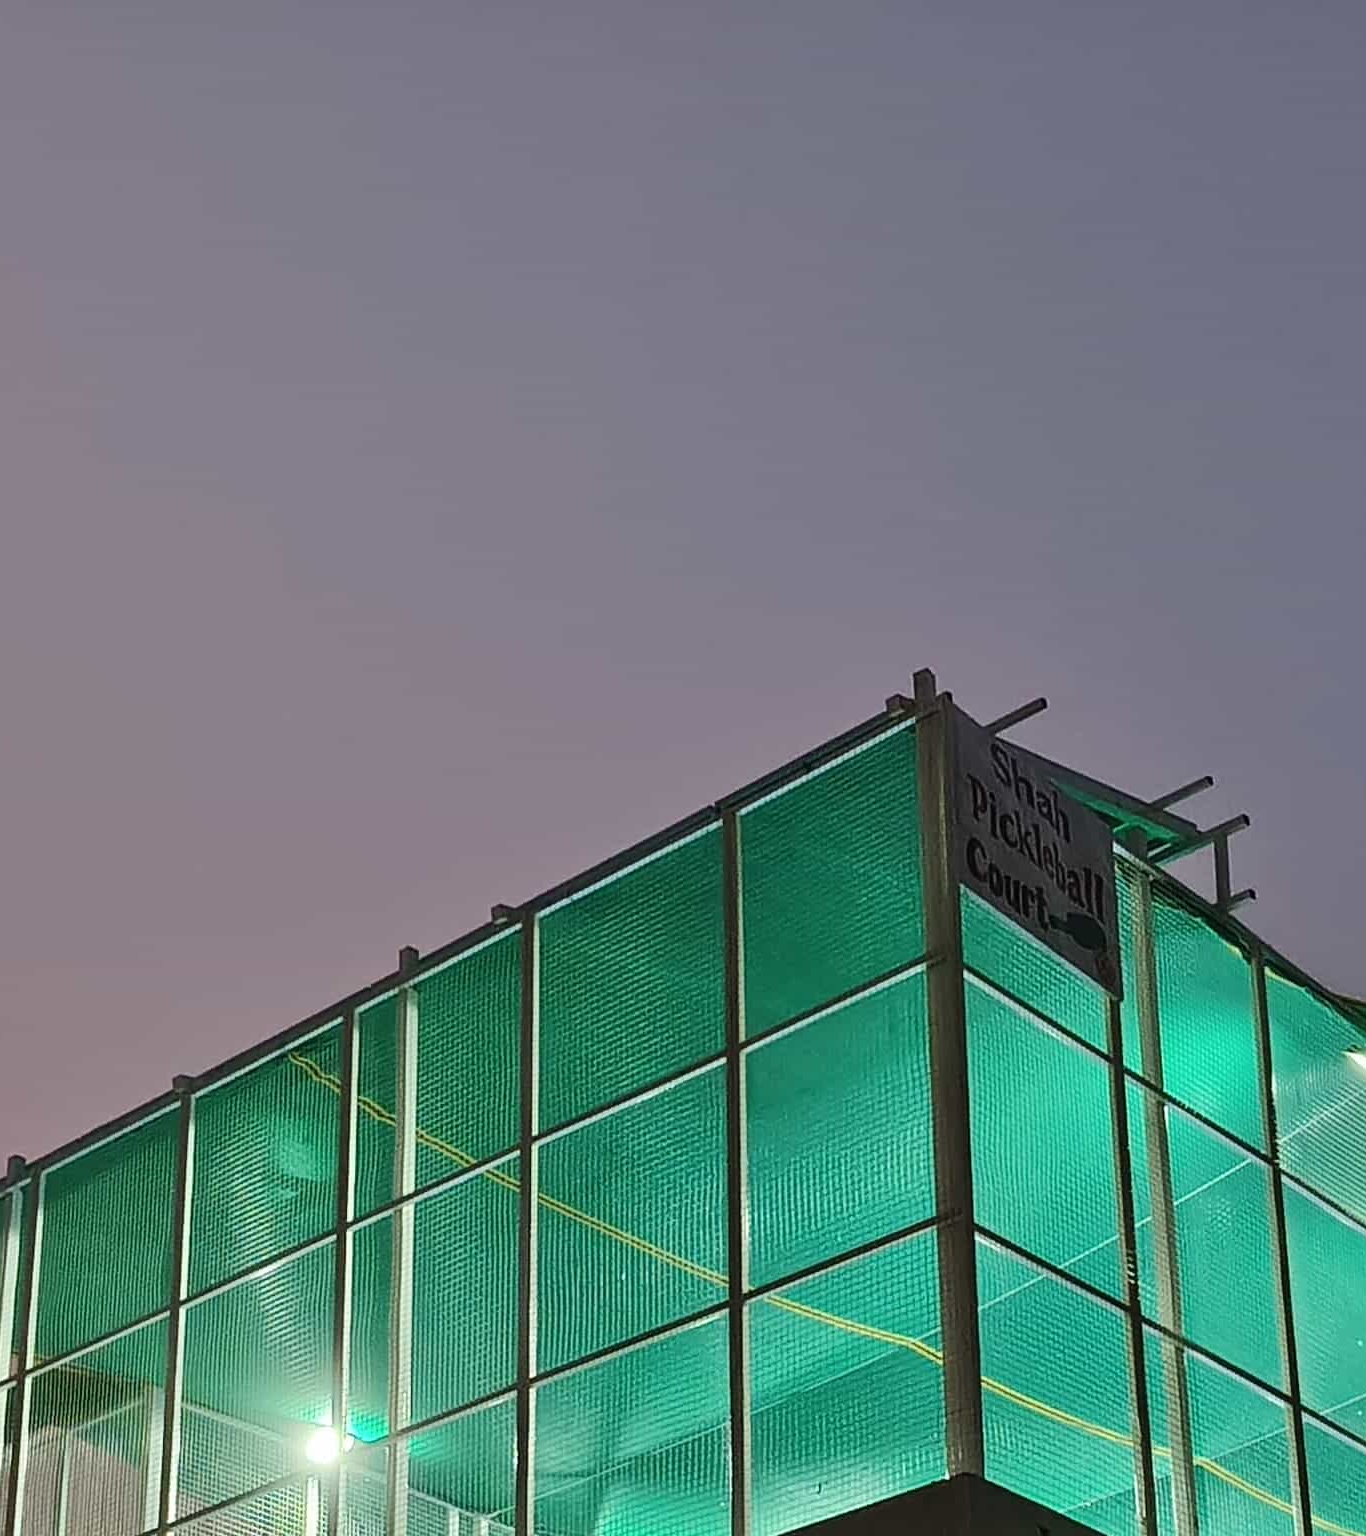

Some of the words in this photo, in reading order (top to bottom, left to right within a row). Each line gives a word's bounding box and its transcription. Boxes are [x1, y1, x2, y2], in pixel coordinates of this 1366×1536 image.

[990, 742, 1072, 845] Shah
[966, 837, 1050, 930] Court
[967, 774, 1105, 923] Pickleball
